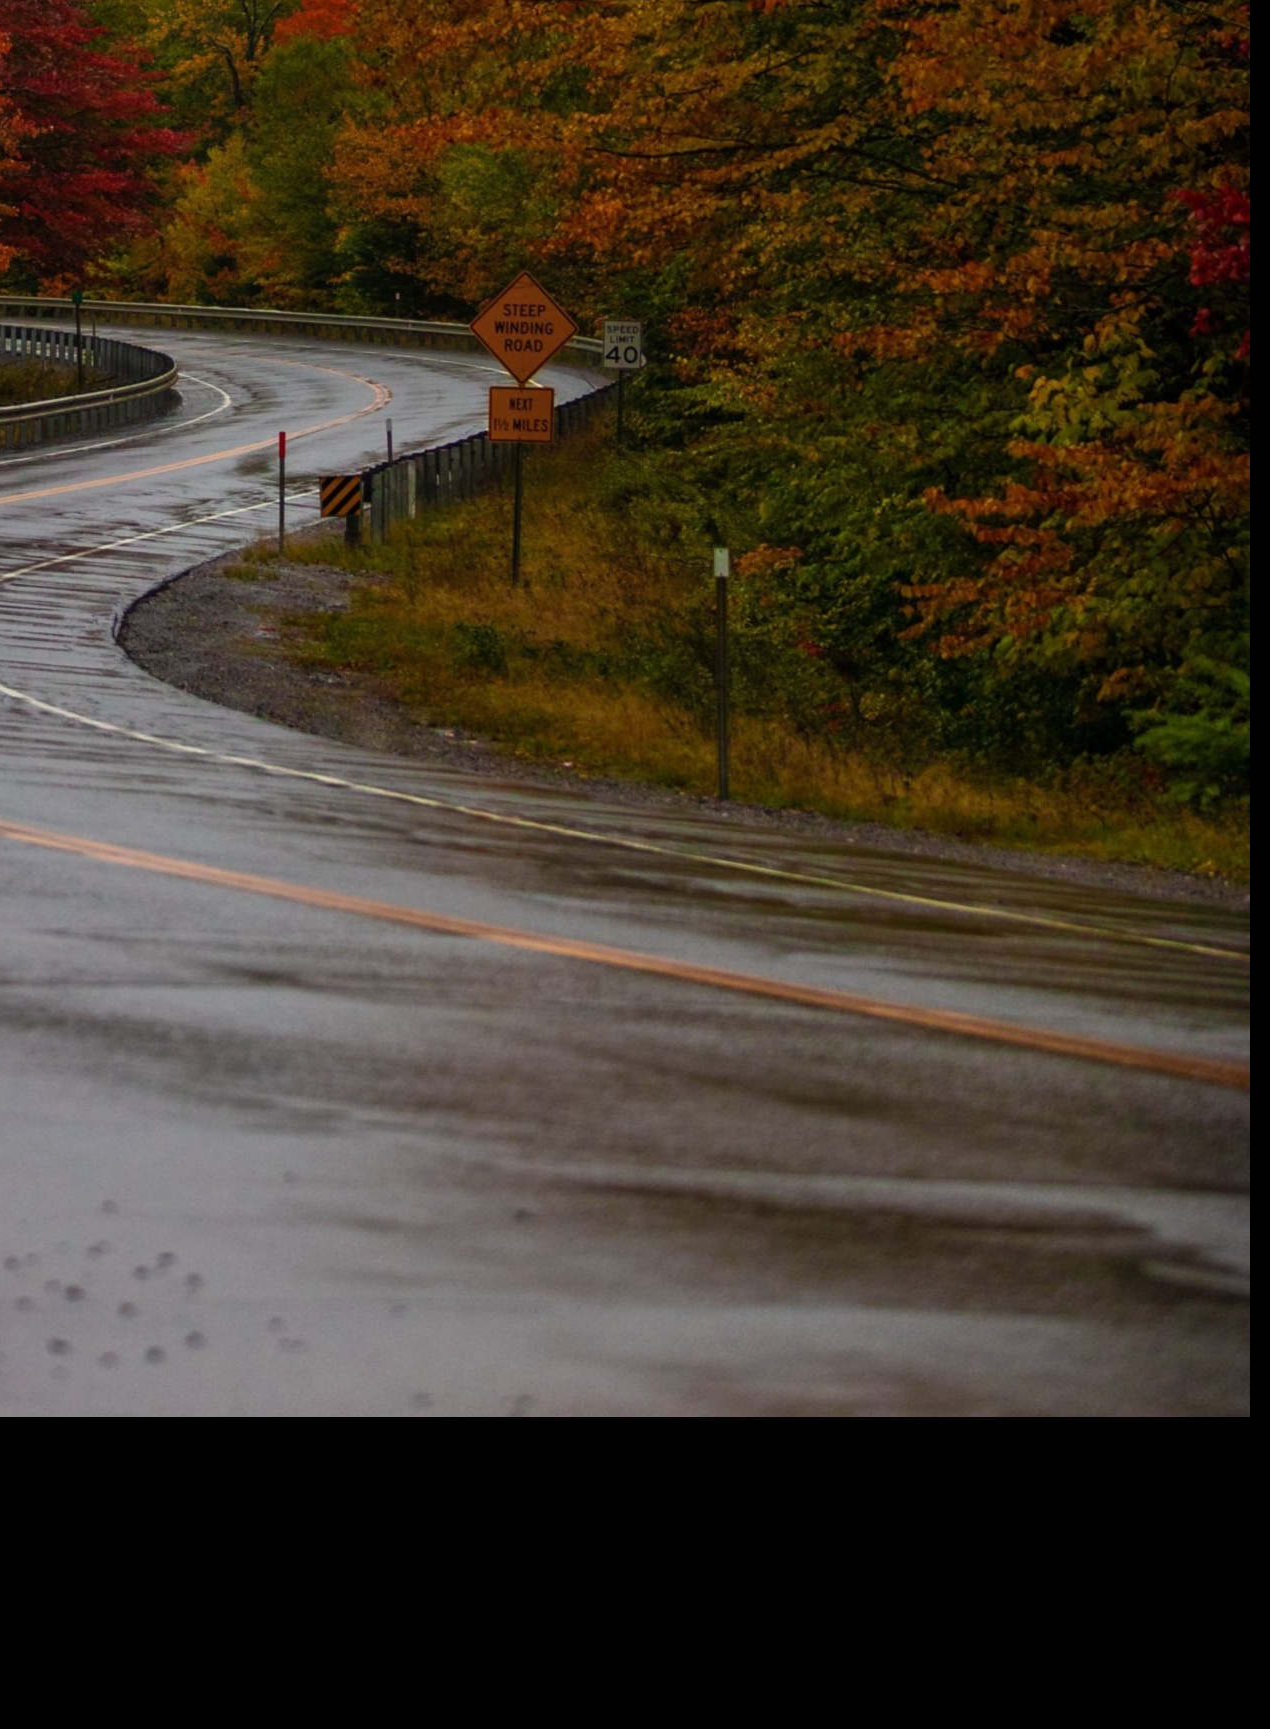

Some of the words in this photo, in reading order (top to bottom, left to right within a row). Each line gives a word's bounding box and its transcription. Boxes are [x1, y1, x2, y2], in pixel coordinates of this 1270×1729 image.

[504, 304, 546, 317] STEEP
[495, 321, 554, 335] WINDING
[607, 325, 639, 334] SPEED
[505, 339, 543, 352] ROAD
[610, 336, 635, 344] LIMIT
[605, 346, 638, 364] 40
[509, 398, 533, 411] NEXT
[513, 419, 549, 432] MILES
